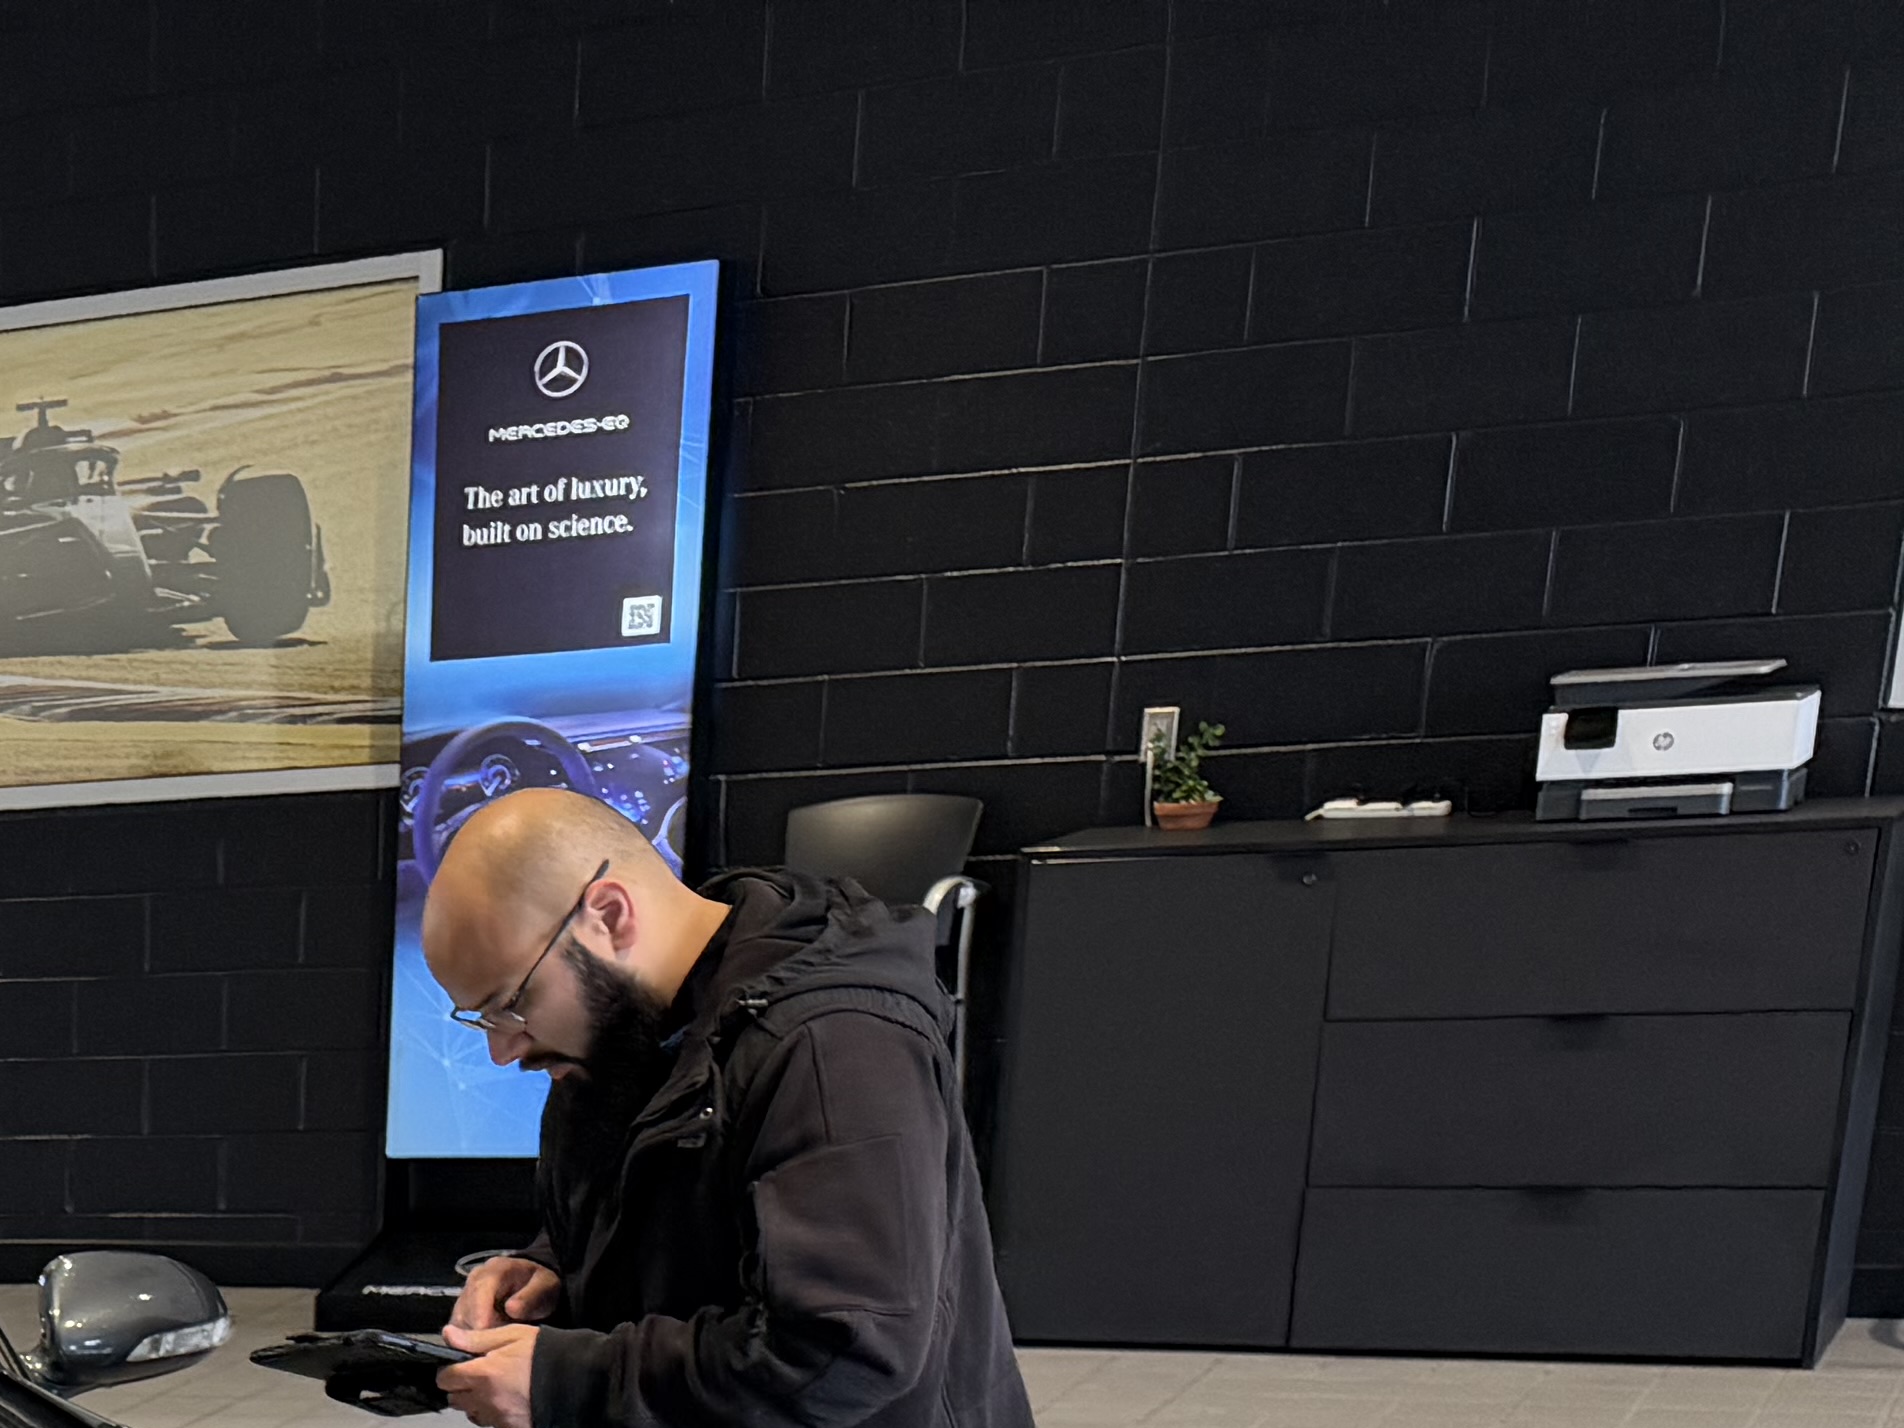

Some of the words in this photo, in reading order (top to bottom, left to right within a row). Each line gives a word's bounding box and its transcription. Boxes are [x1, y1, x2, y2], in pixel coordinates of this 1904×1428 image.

[488, 413, 630, 443] MERCEDES-EQ
[464, 485, 504, 510] The
[508, 483, 540, 506] art
[543, 476, 568, 502] of
[570, 475, 648, 501] luxury,
[462, 520, 511, 547] built
[515, 522, 543, 542] on
[547, 513, 634, 539] science.
